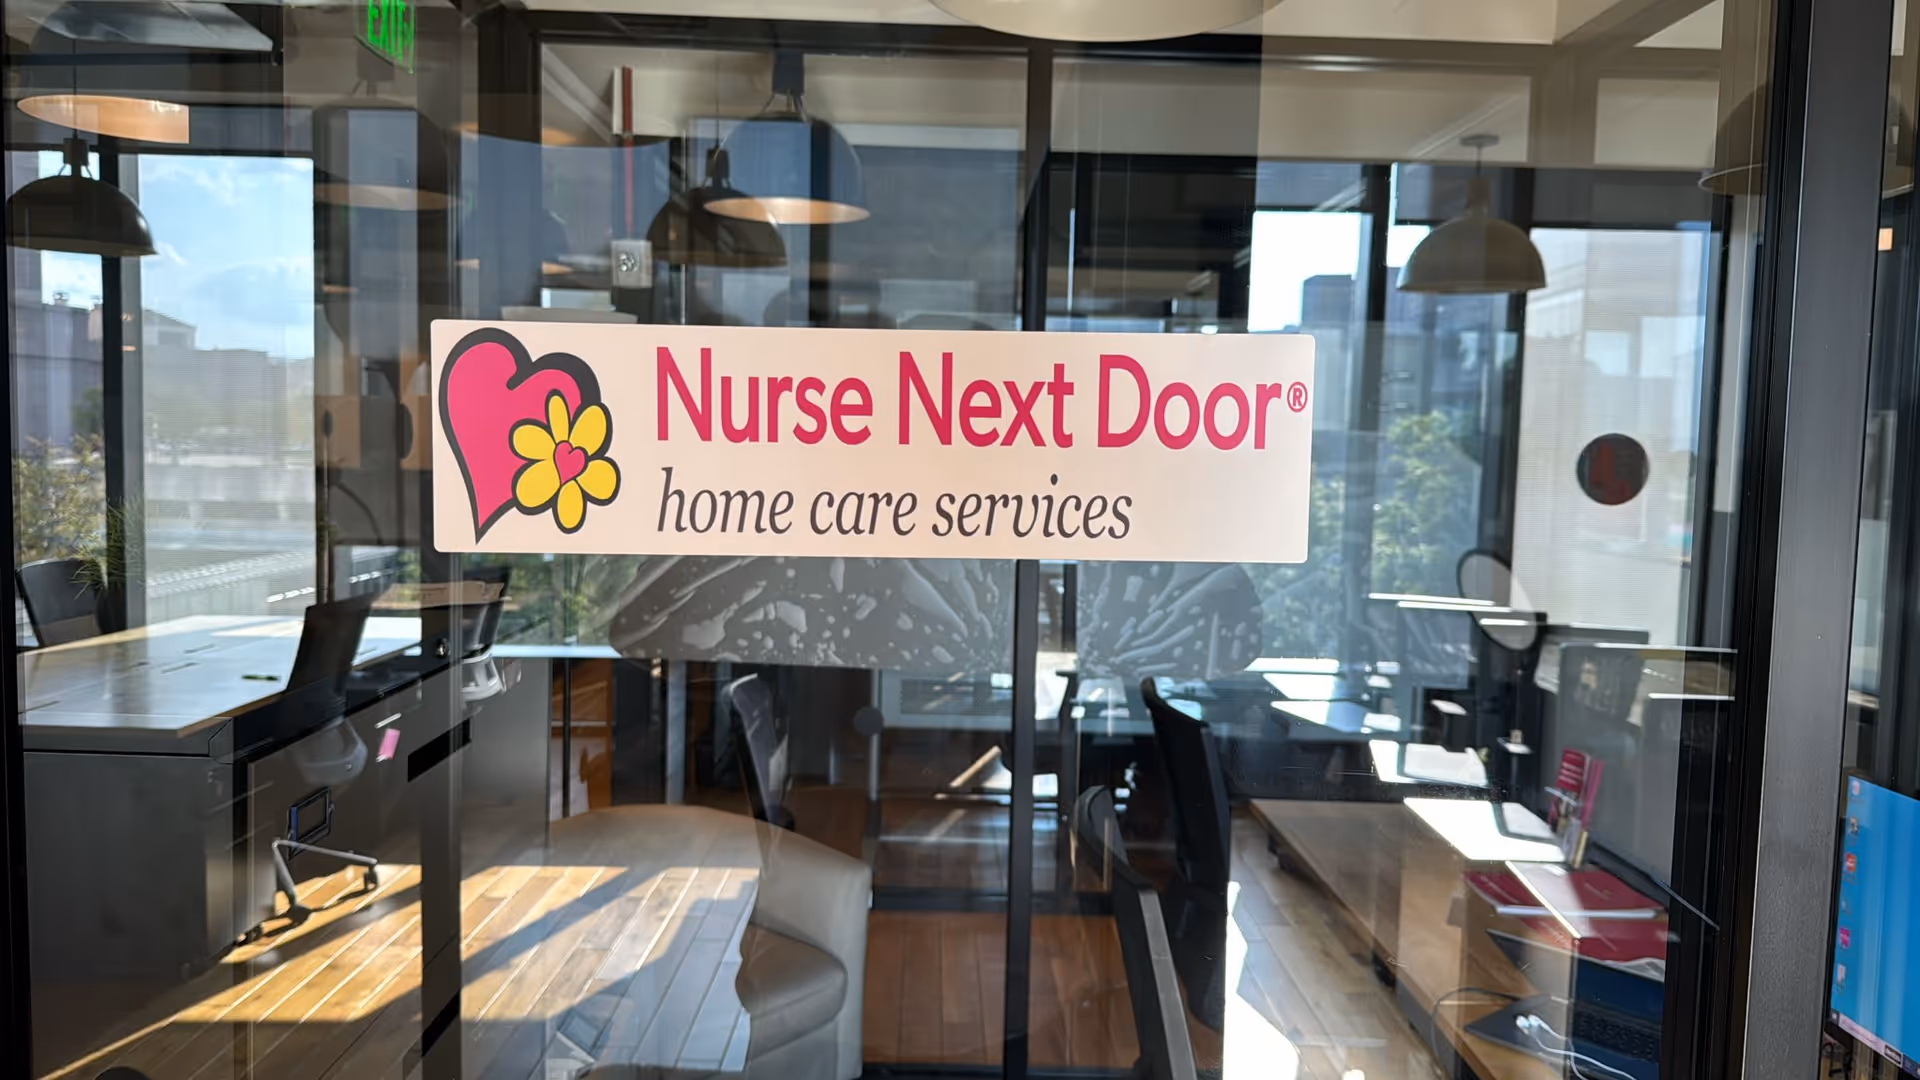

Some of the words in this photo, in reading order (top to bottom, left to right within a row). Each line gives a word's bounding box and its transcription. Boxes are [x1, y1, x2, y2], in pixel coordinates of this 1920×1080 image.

[656, 346, 873, 446] Nurse
[898, 351, 1075, 449] Next
[657, 466, 793, 535] home
[810, 491, 917, 536] care
[931, 473, 1133, 540] services
